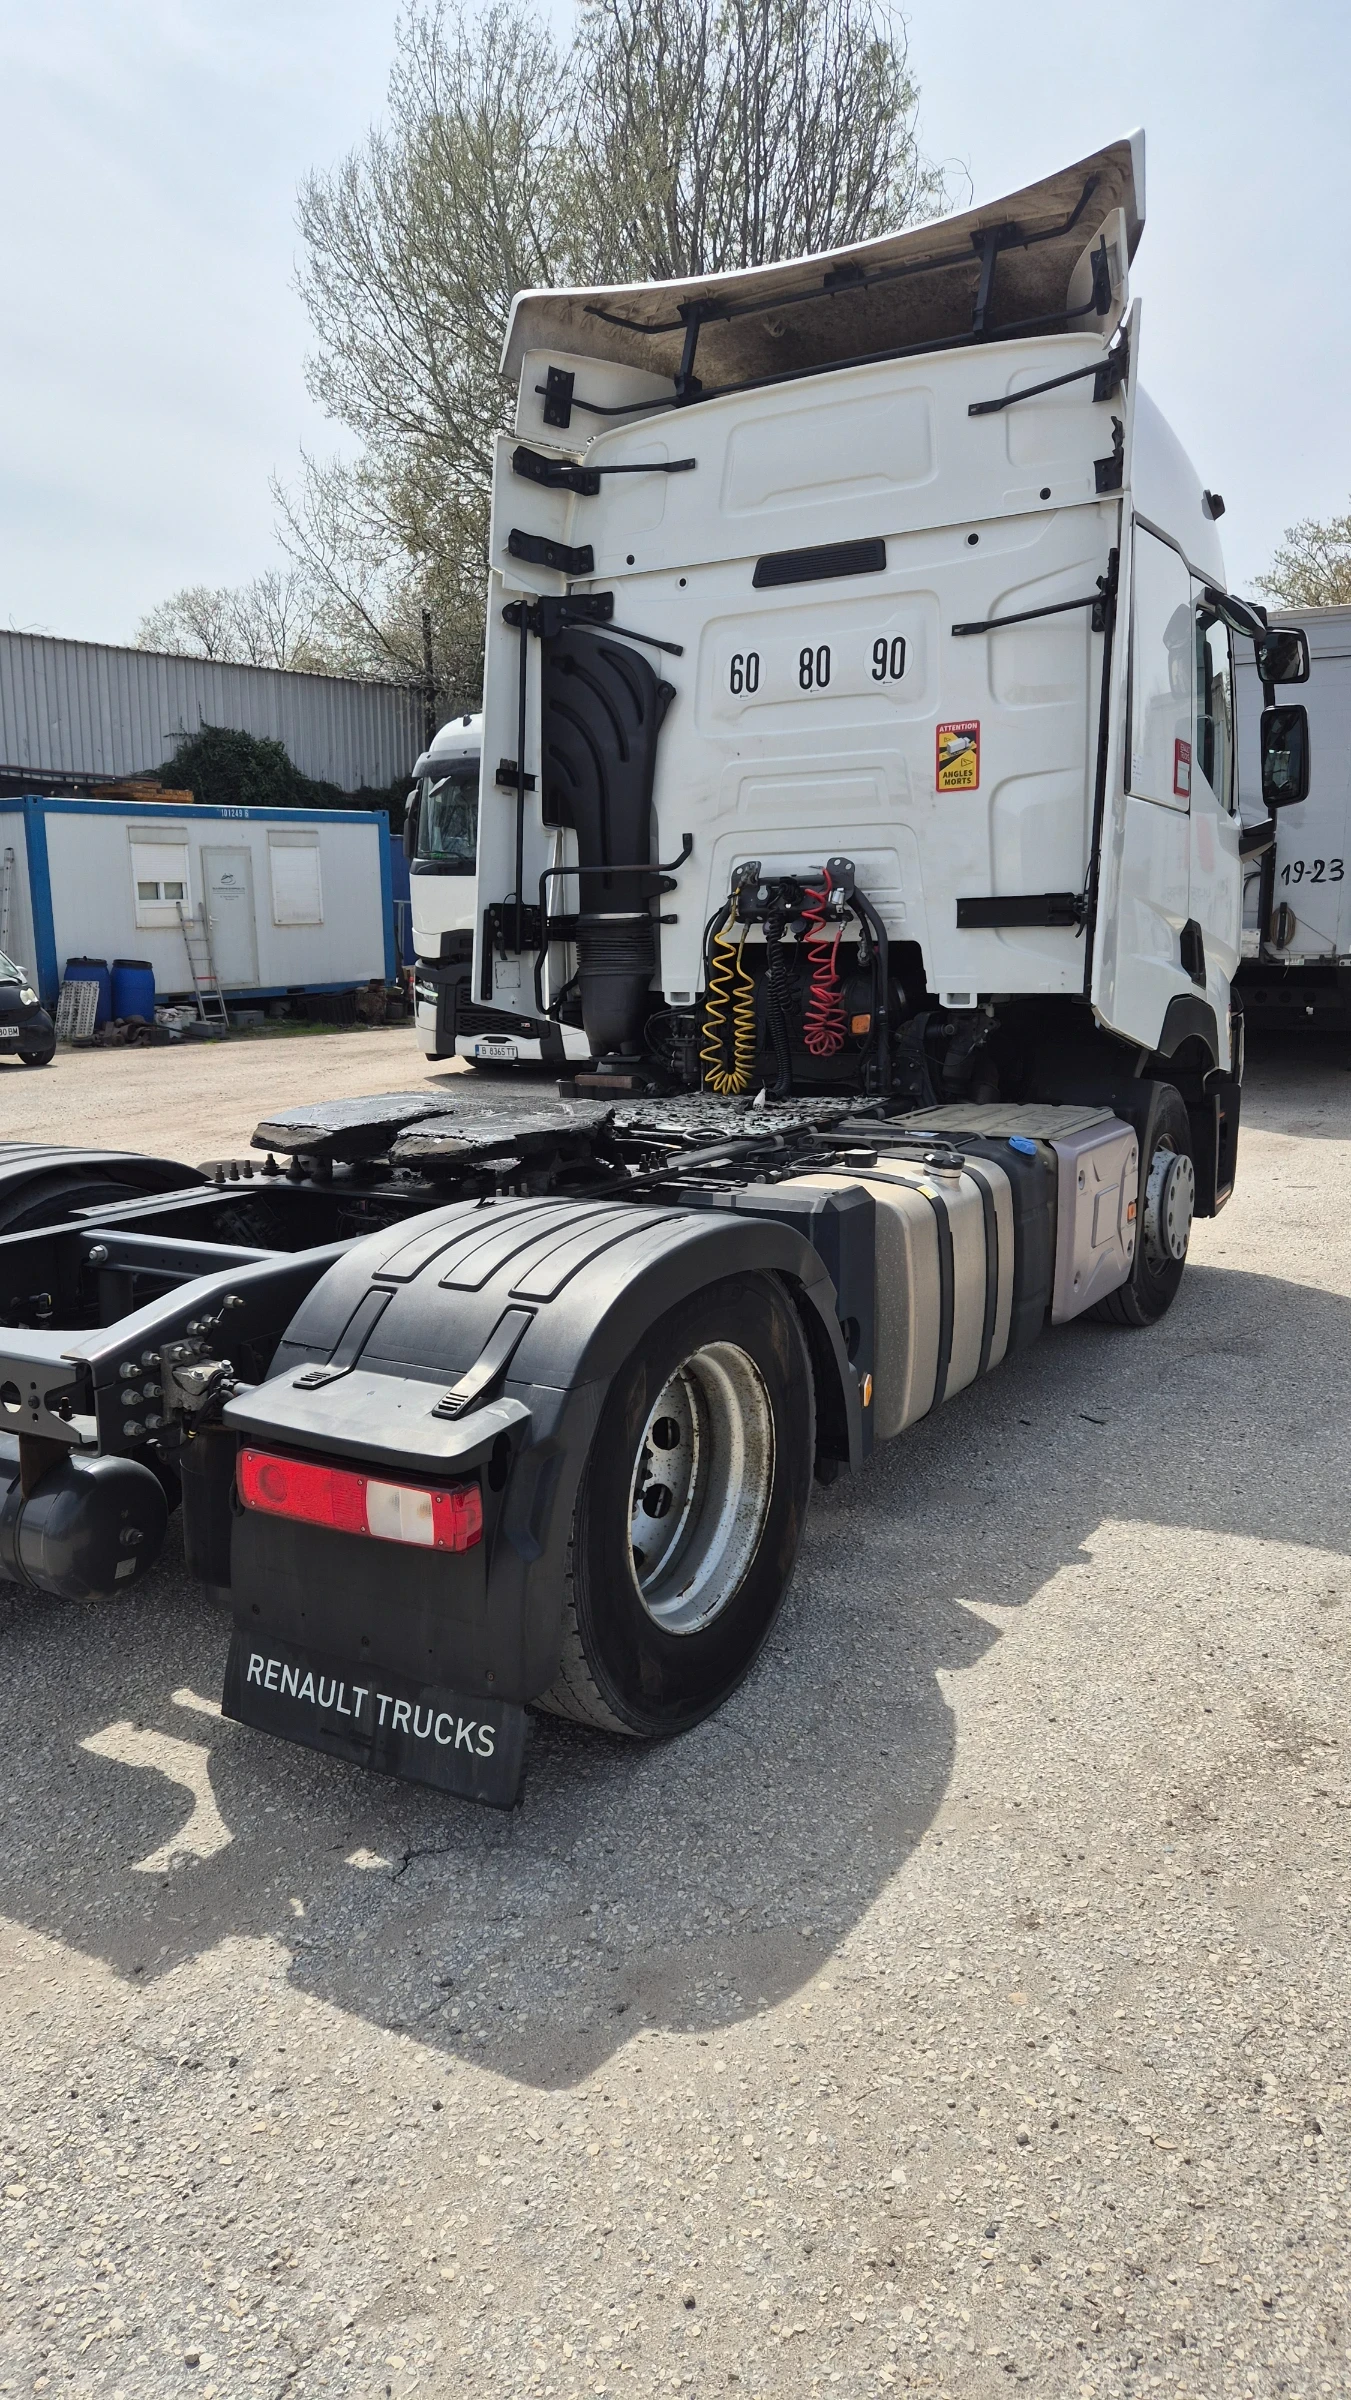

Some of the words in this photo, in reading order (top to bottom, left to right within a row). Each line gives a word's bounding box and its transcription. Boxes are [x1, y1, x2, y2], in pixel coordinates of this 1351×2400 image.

[729, 651, 760, 695] 60
[799, 644, 831, 690] 80
[871, 636, 907, 681] 90
[939, 722, 978, 732] ATTENTION
[942, 770, 973, 778] ANGLES
[944, 778, 972, 786] MORTS
[1281, 858, 1345, 886] 19-23
[246, 1653, 369, 1718] RENAULT
[376, 1693, 496, 1757] TRUCKS
